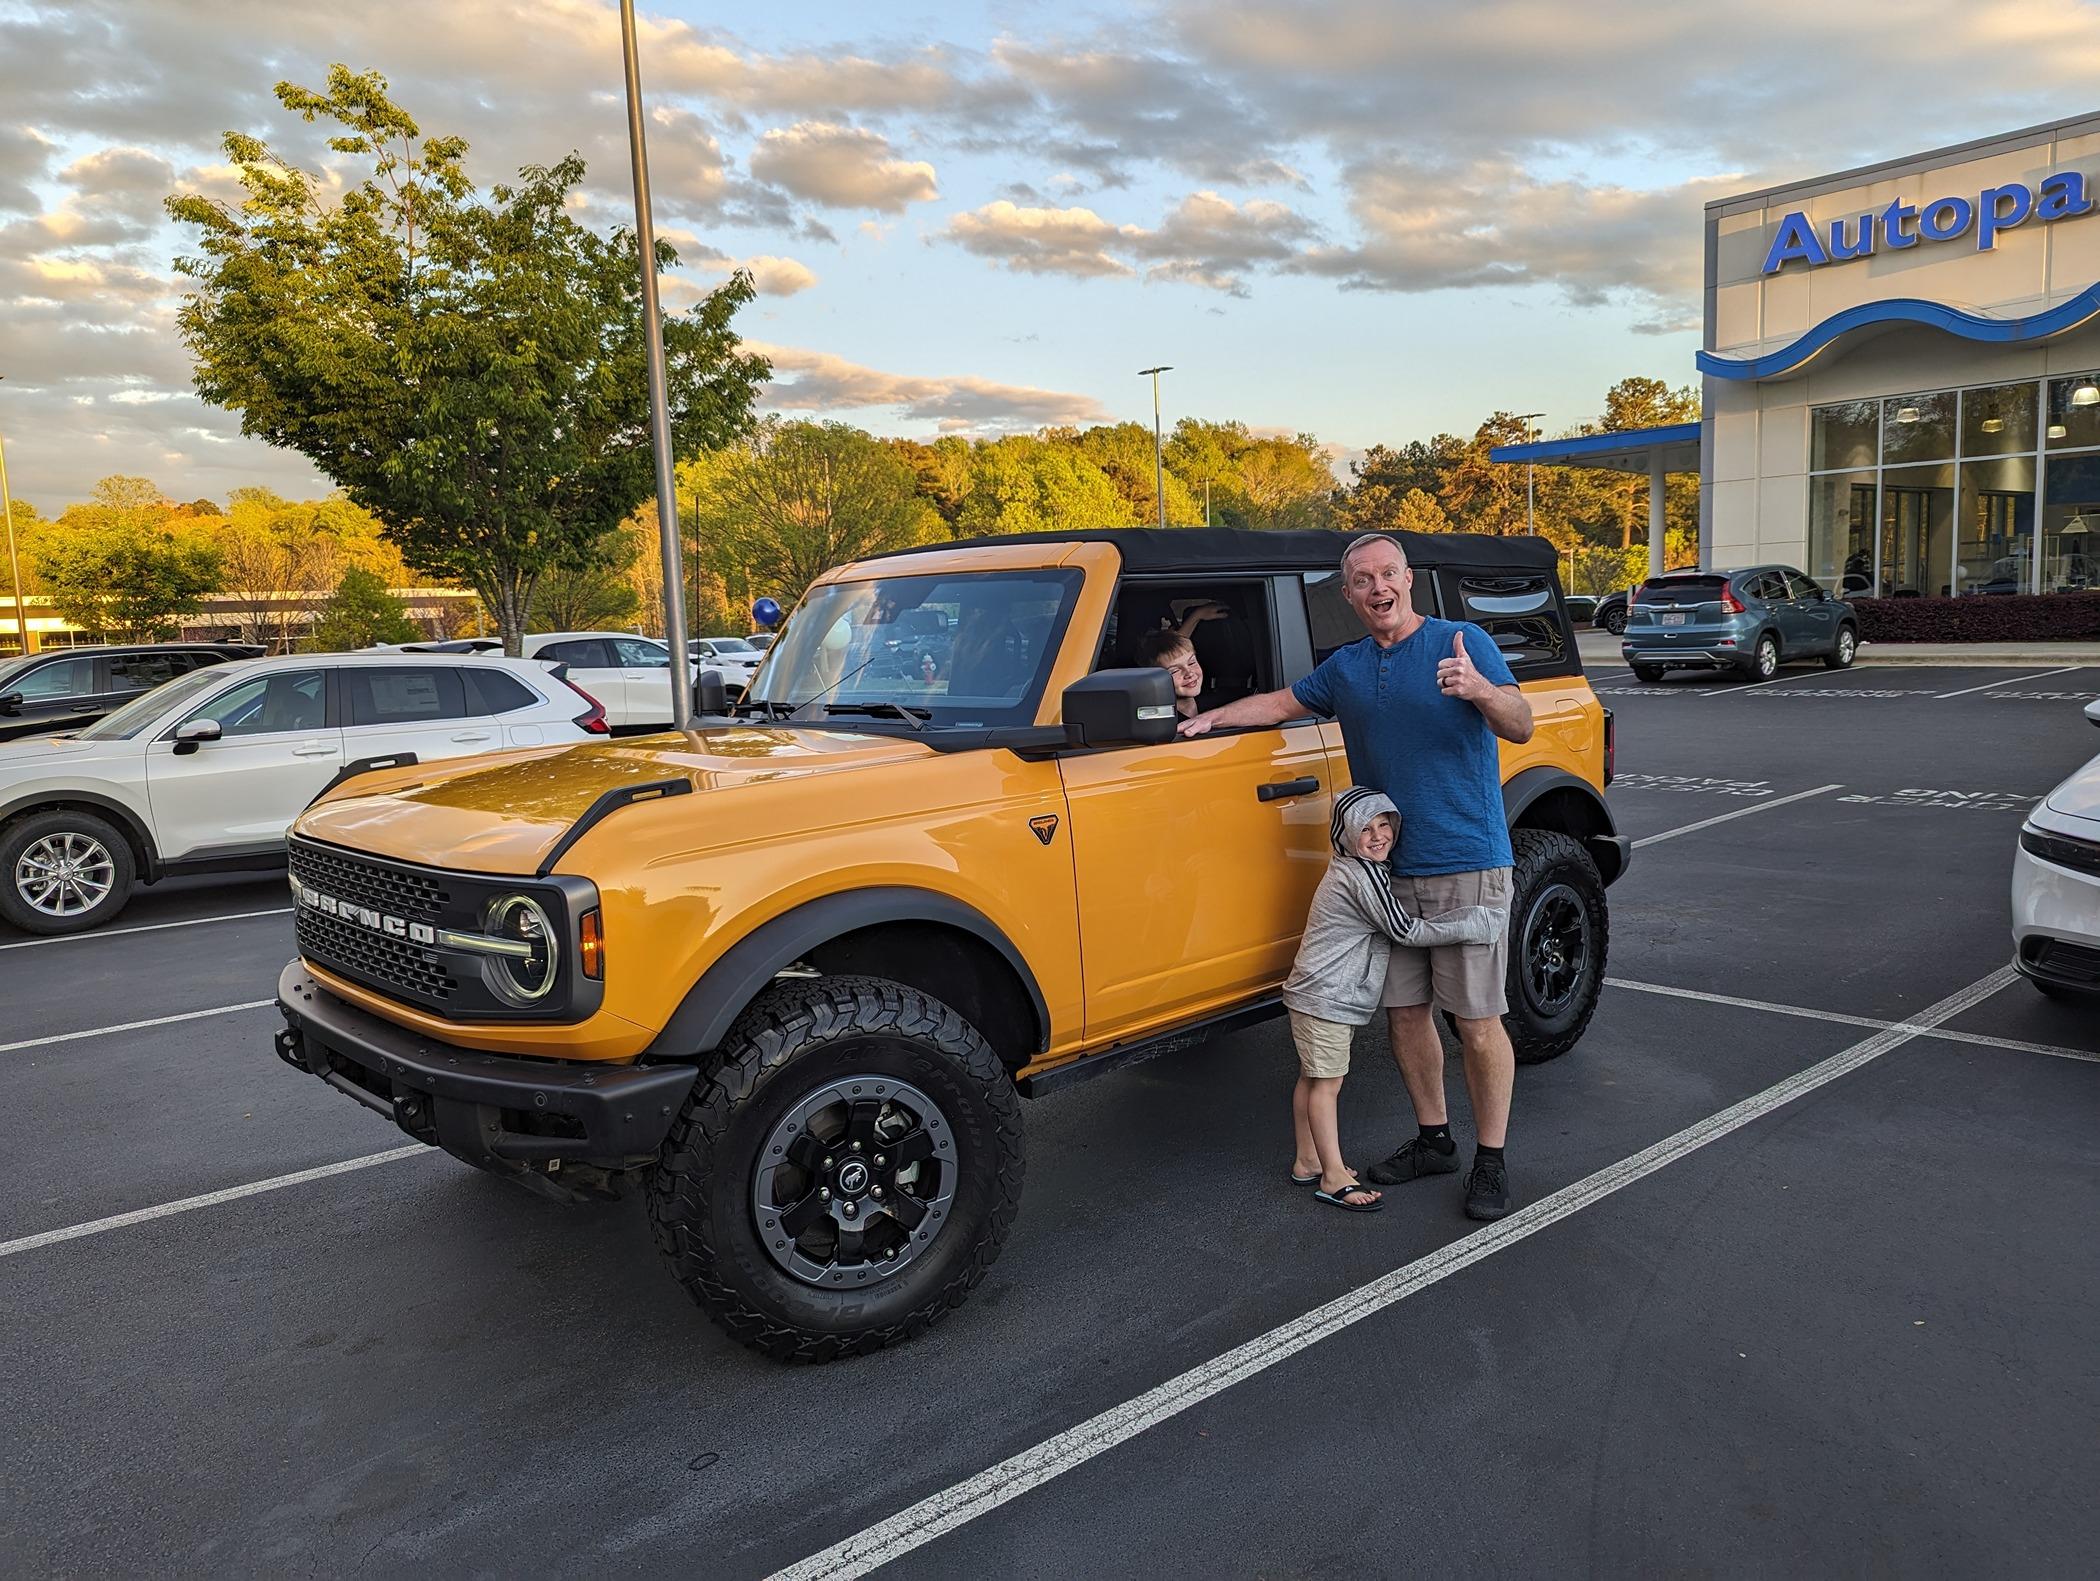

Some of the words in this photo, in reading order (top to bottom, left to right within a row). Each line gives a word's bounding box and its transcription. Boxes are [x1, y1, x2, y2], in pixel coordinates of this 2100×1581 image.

[1761, 171, 2094, 274] Autopa
[1611, 781, 1776, 797] CUSTO
[1612, 774, 1771, 788] PARKI
[1892, 788, 2045, 802] KING
[302, 887, 435, 944] BRONCO
